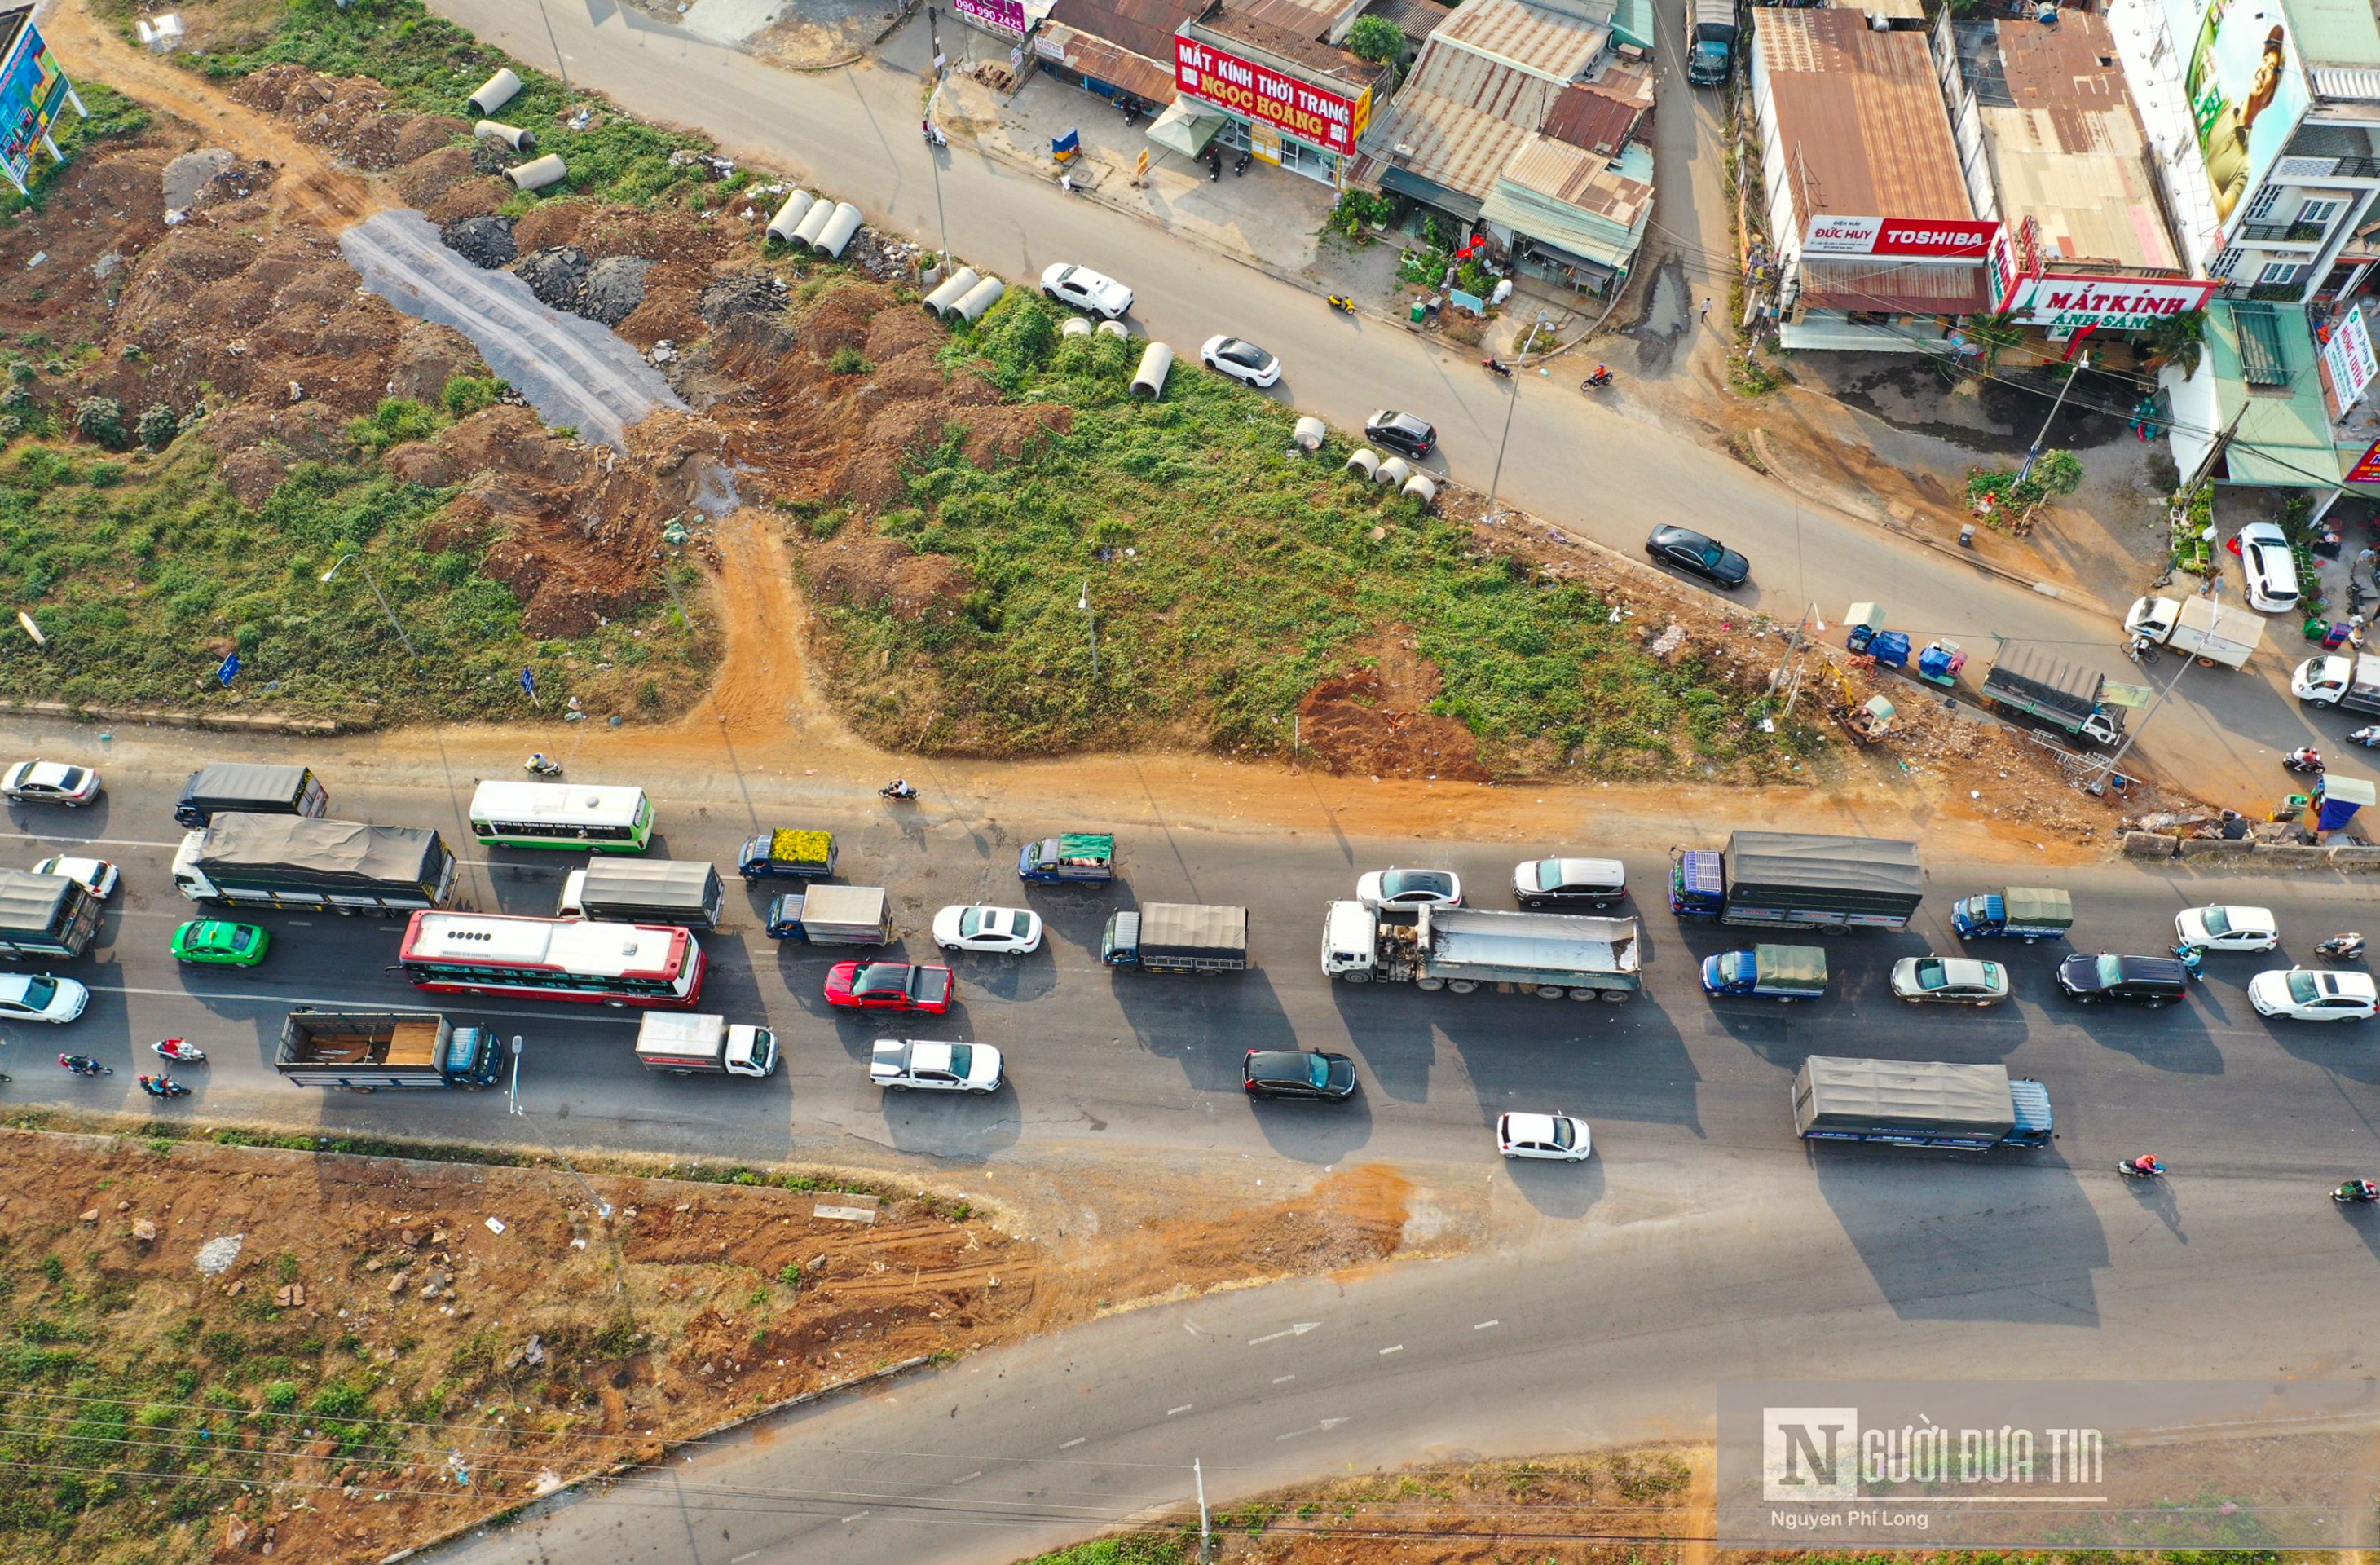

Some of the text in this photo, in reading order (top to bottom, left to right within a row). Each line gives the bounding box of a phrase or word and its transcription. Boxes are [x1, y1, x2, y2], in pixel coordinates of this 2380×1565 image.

[956, 0, 975, 12] 090
[977, 7, 996, 20] 990
[998, 14, 1023, 30] 2425
[1201, 73, 1323, 137] NGỌC HOÀNG
[1218, 59, 1253, 89] KÍNH
[1257, 74, 1294, 104] THỜI
[1298, 90, 1350, 126] TRANG
[1227, 104, 1245, 115] GUCCI
[1298, 132, 1320, 143] POLICE
[1814, 227, 1873, 240] ĐỨC HUY
[1887, 230, 1983, 245] TOSHIBA
[2050, 309, 2099, 327] ÁNH
